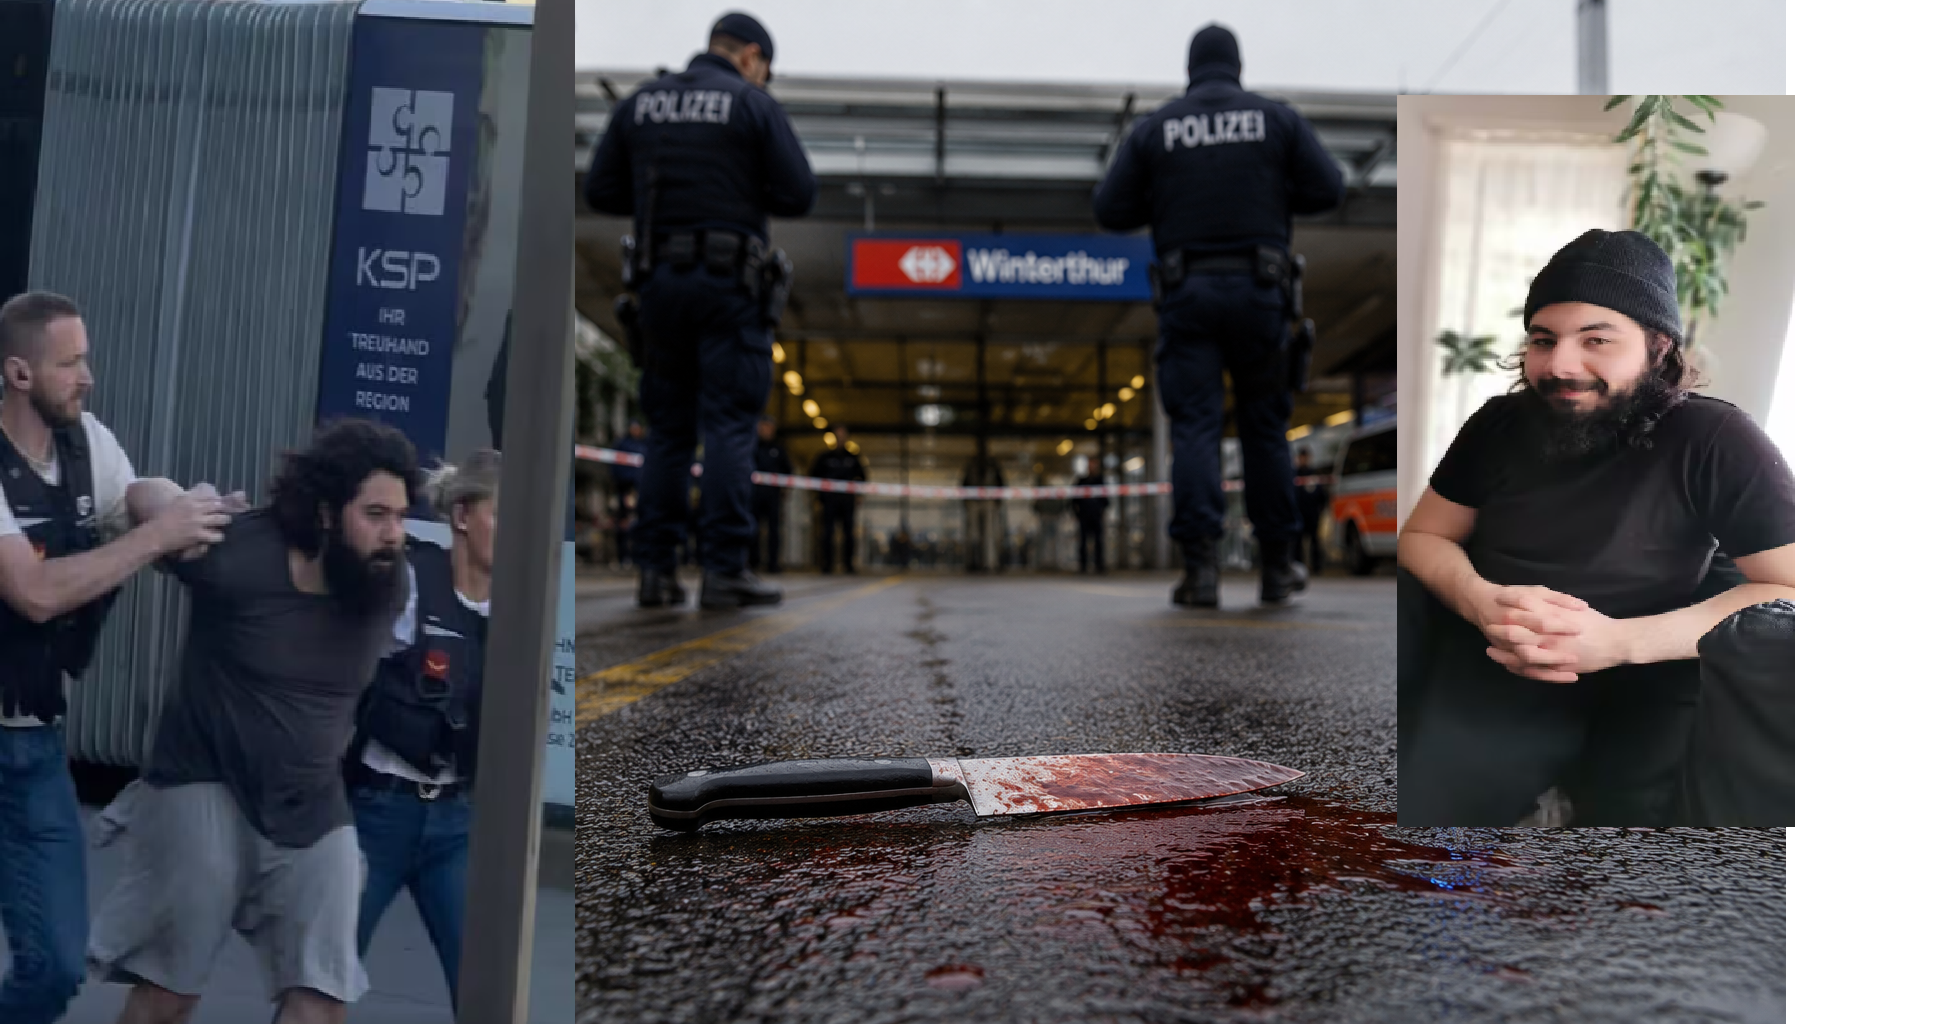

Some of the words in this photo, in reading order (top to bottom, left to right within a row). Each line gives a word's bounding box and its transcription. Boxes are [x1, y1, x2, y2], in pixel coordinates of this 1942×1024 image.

[634, 90, 732, 126] POLIZEI
[1163, 109, 1265, 152] POLIZEI
[356, 247, 441, 290] KSP
[967, 248, 1130, 285] Winterthur
[379, 308, 405, 325] IHR
[352, 332, 429, 355] TREUHAND
[356, 362, 384, 381] AUS
[388, 366, 418, 385] DER
[356, 390, 409, 412] REGION
